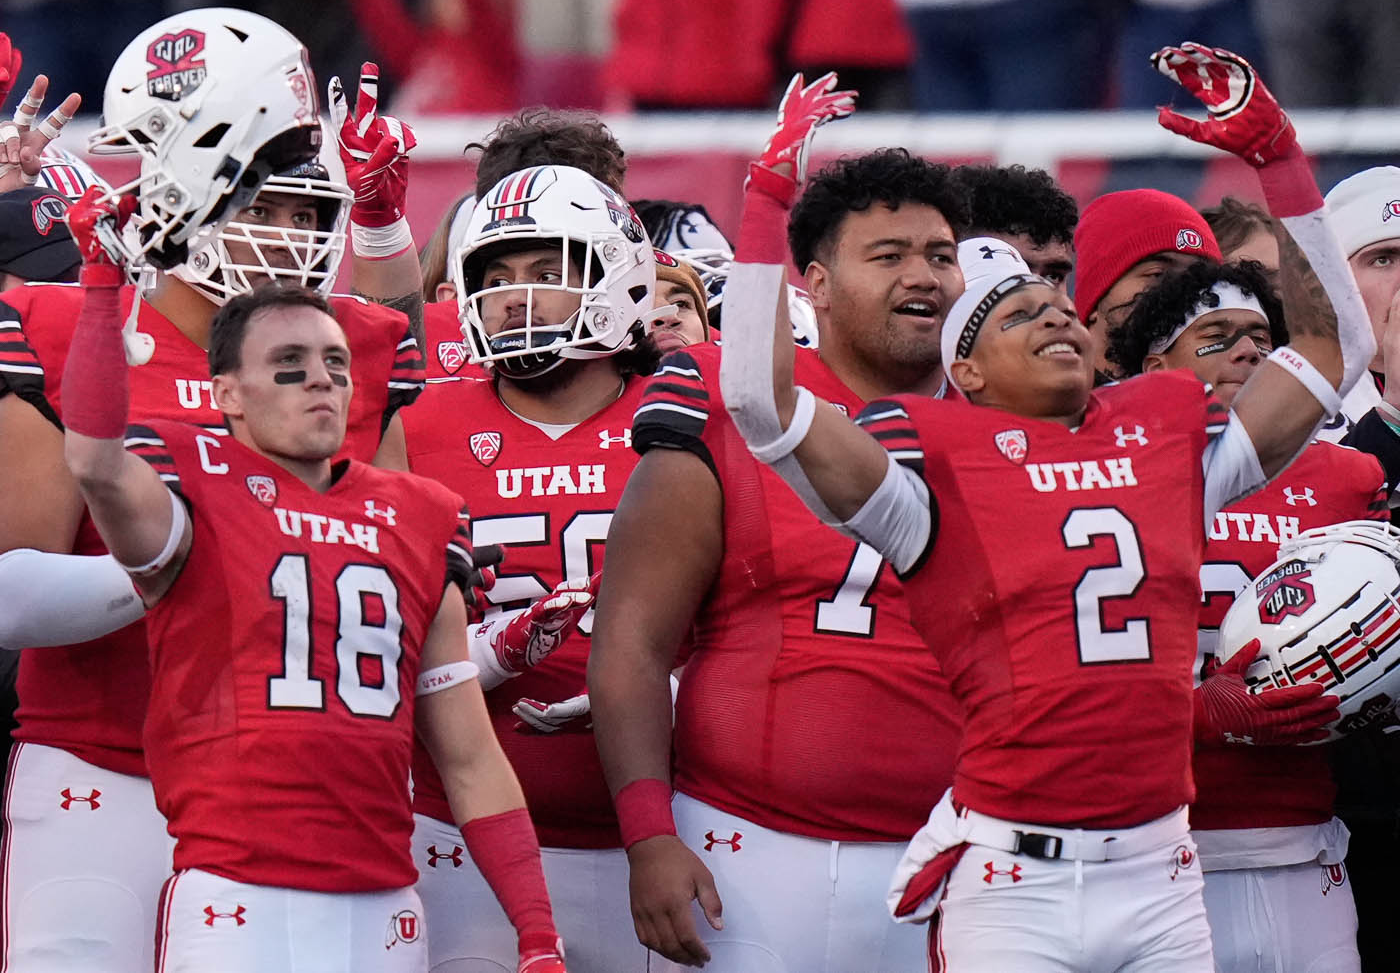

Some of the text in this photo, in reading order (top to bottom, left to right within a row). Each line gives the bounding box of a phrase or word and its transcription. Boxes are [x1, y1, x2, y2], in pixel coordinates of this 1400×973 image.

[155, 34, 197, 61] TJAL
[148, 68, 207, 96] FOREVER
[443, 354, 460, 368] 12
[1278, 352, 1303, 370] UTAH
[195, 434, 229, 475] C
[471, 433, 501, 454] PAC
[478, 446, 494, 460] 12
[1006, 445, 1024, 461] 12
[496, 464, 606, 499] UTAH
[1025, 457, 1138, 493] UTAH
[273, 508, 380, 554] UTAH
[1209, 511, 1301, 546] UTAH
[1061, 506, 1153, 667] 2
[1266, 586, 1304, 614] TJAL
[267, 553, 404, 721] 18
[421, 673, 453, 689] UTAH
[399, 917, 416, 939] U
